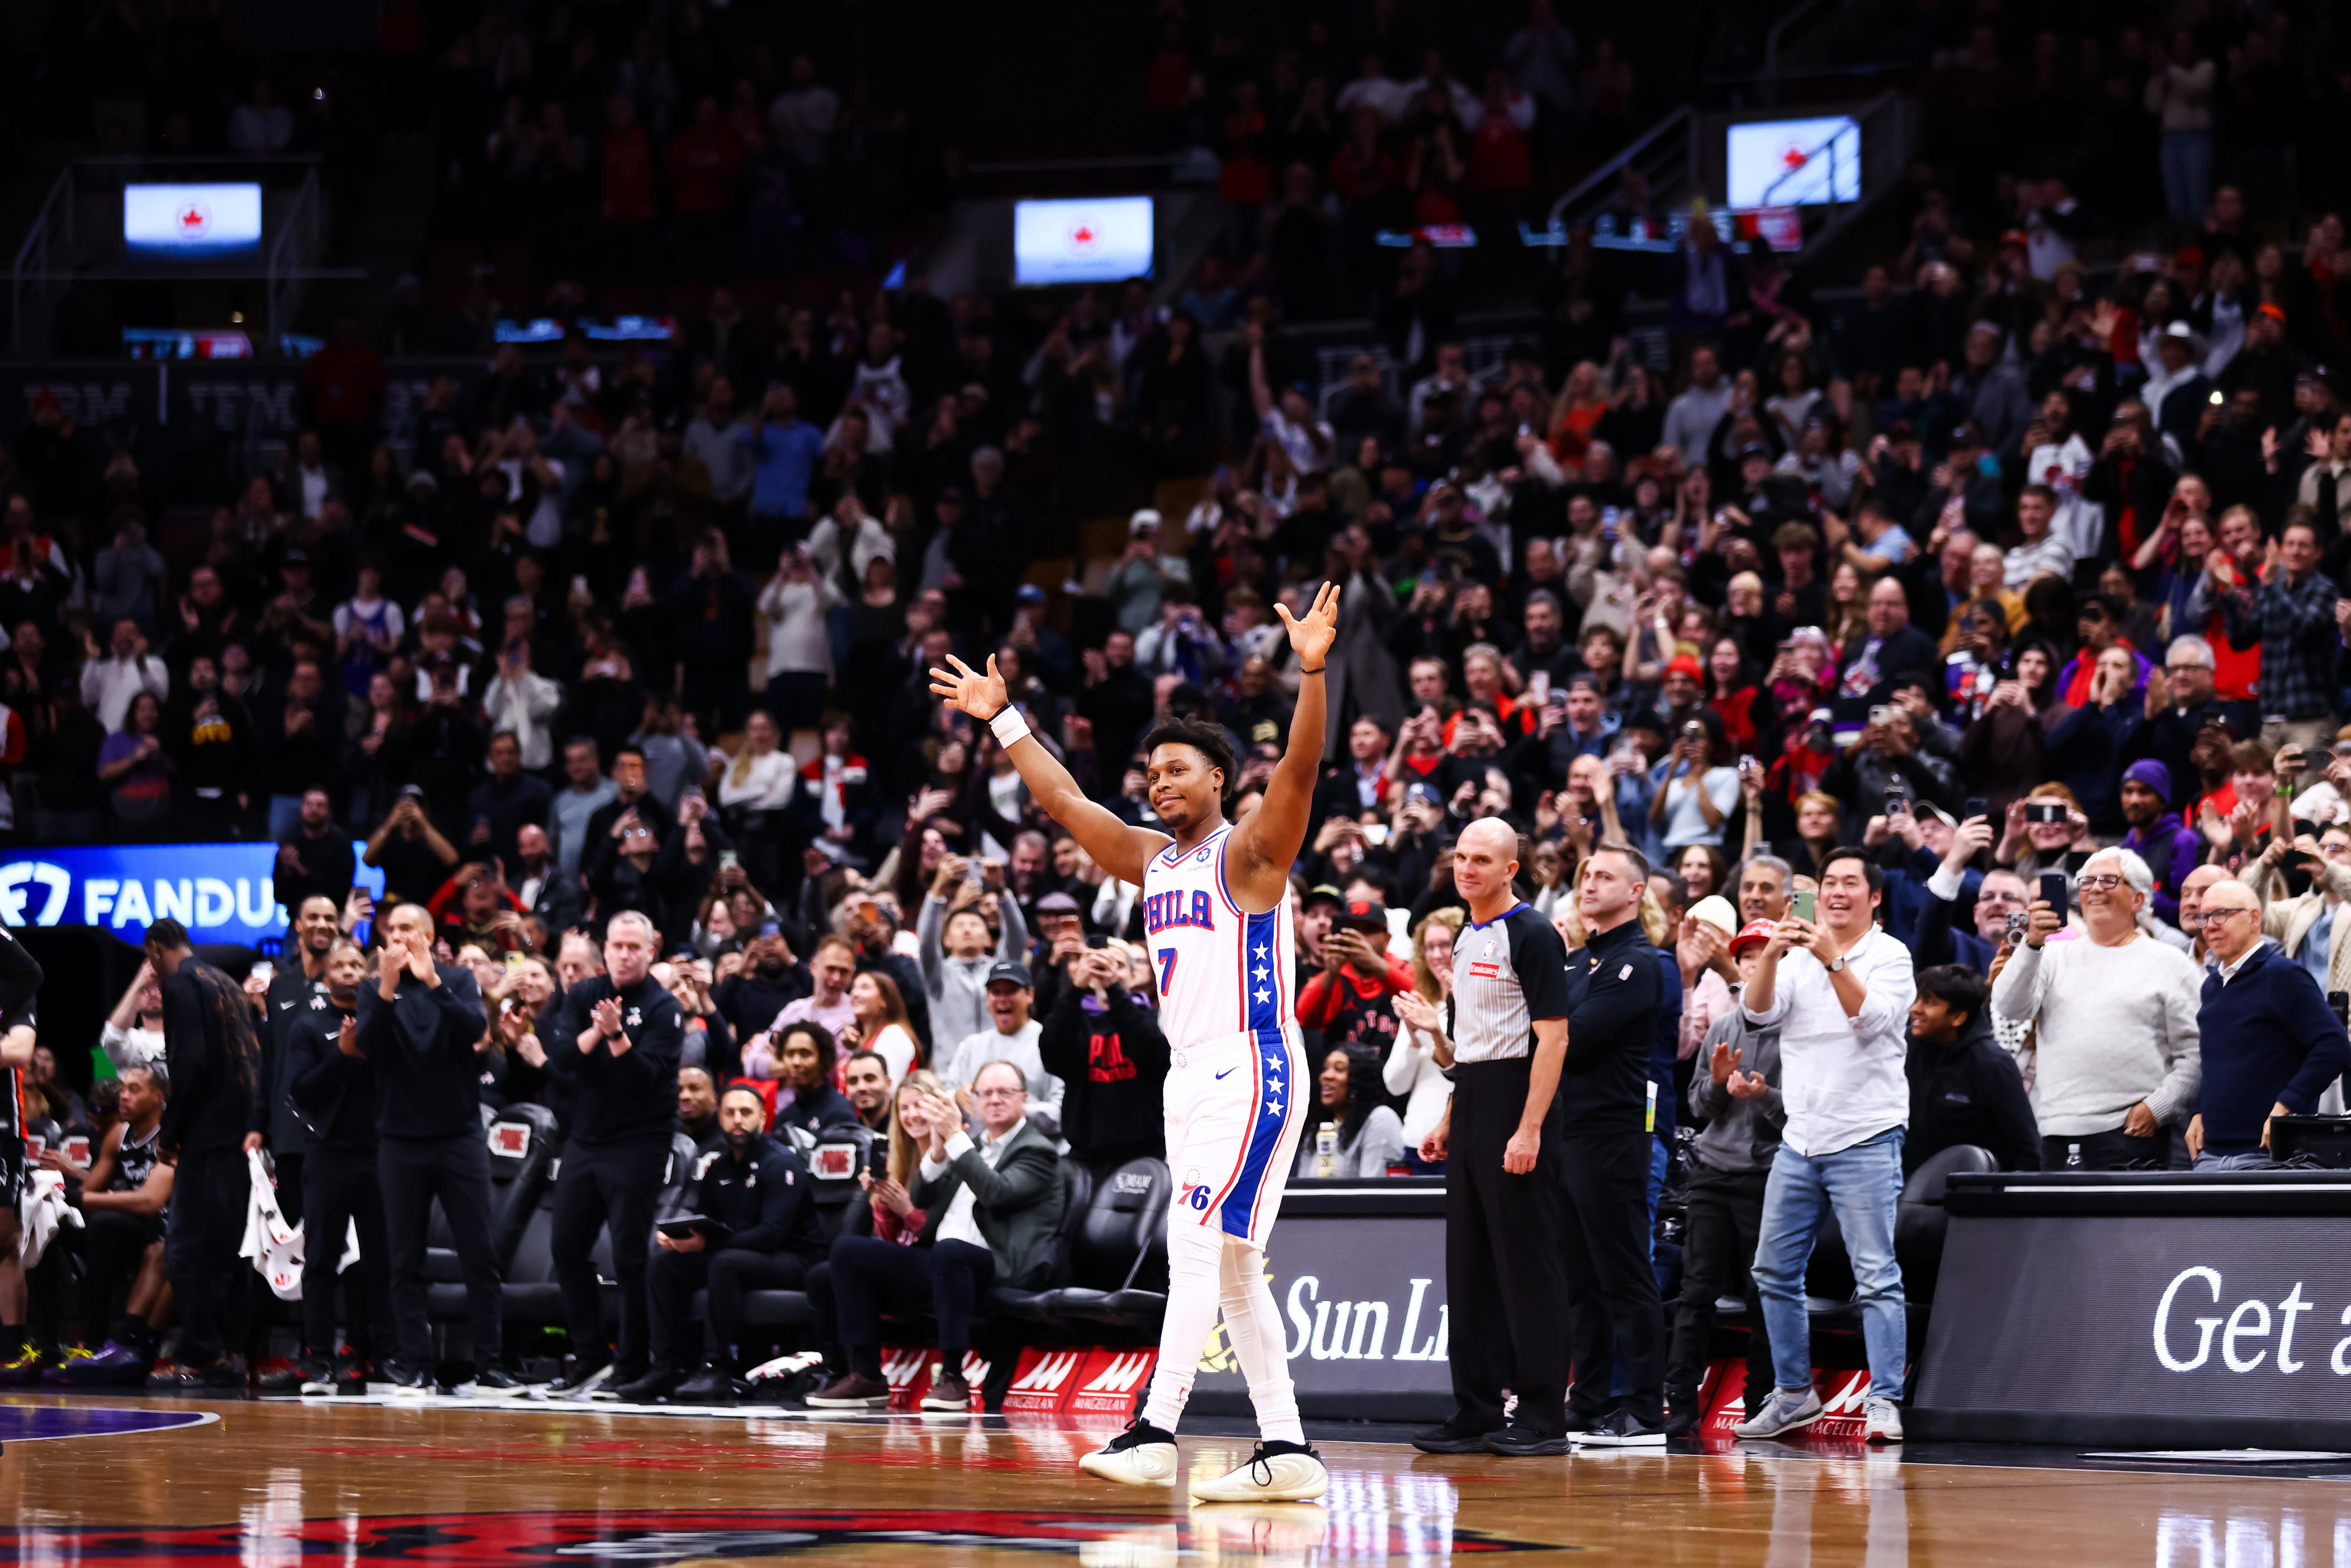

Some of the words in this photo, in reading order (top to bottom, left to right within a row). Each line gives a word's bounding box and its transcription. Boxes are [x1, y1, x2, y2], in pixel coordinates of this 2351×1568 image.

[1158, 948, 1177, 997] 7
[1177, 1181, 1211, 1210] 76
[1286, 1275, 1389, 1360] Sun
[2153, 1266, 2314, 1375] Get
[1805, 1420, 1866, 1437] MAGELLA
